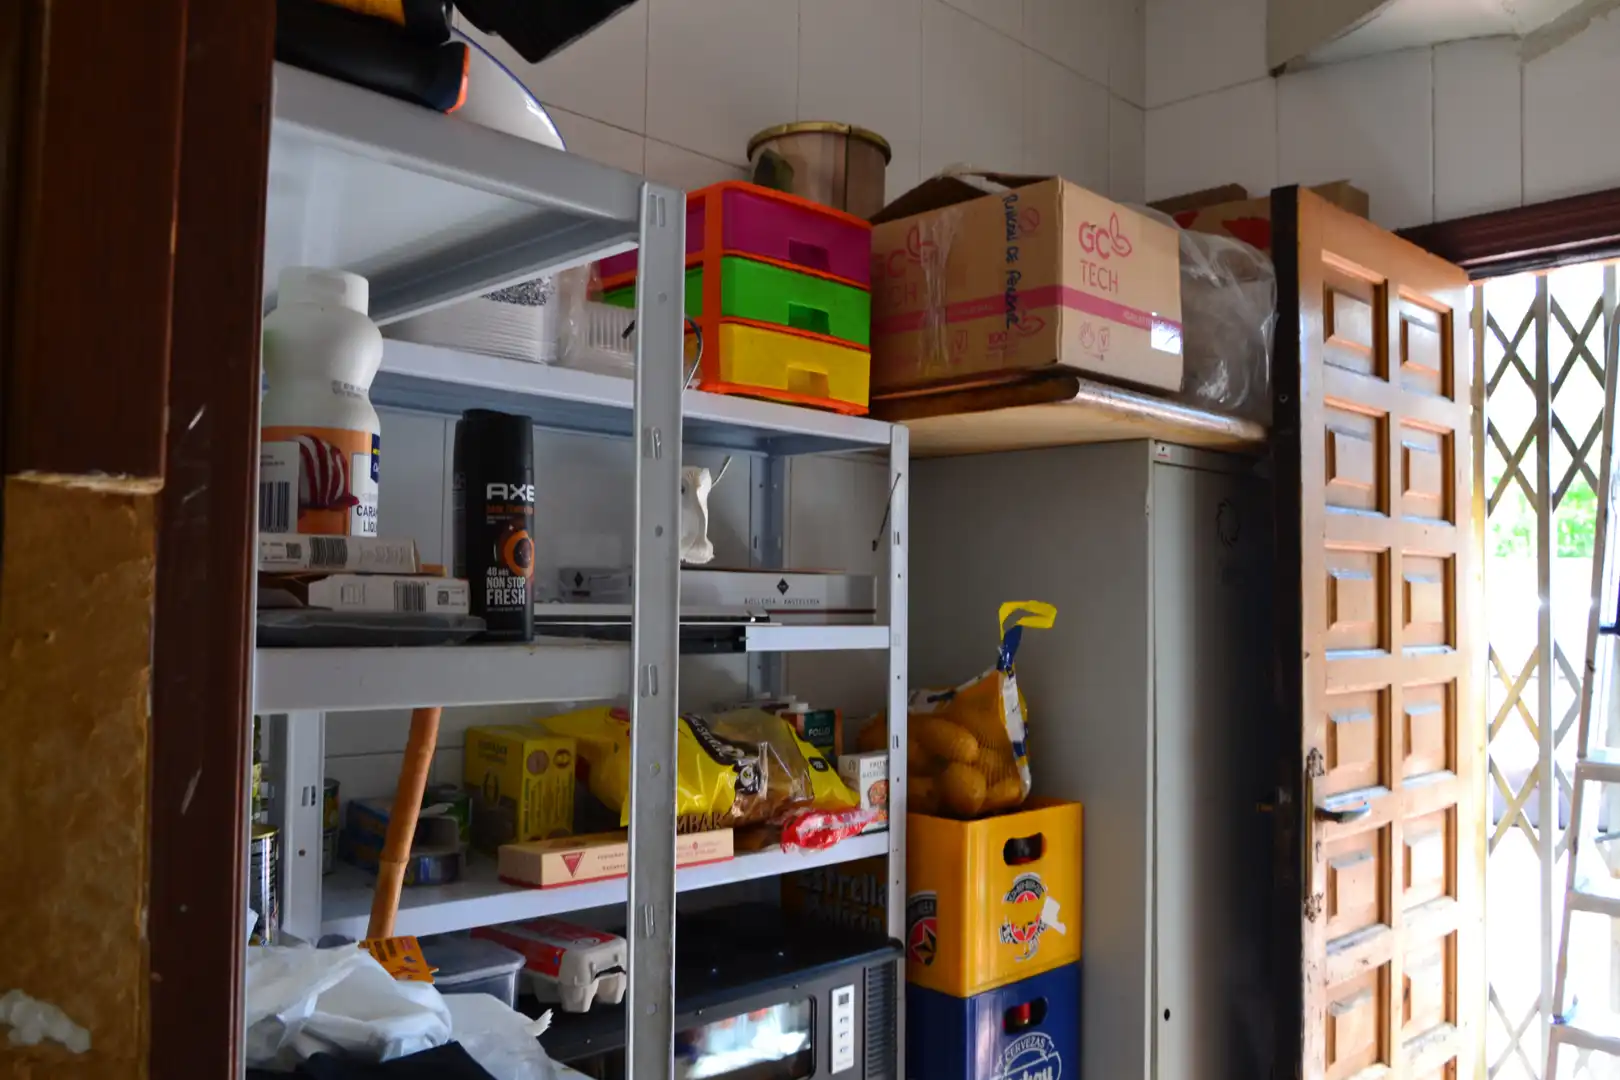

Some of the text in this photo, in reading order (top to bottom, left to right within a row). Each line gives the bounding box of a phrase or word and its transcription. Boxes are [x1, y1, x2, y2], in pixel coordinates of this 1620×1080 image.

[1080, 259, 1118, 294] TECH
[486, 483, 535, 502] AXE
[357, 506, 379, 518] CARA
[486, 567, 498, 577] 48
[486, 576, 526, 589] NON STOP
[486, 589, 526, 605] FRESH
[1006, 1035, 1046, 1061] CERVEZAS
